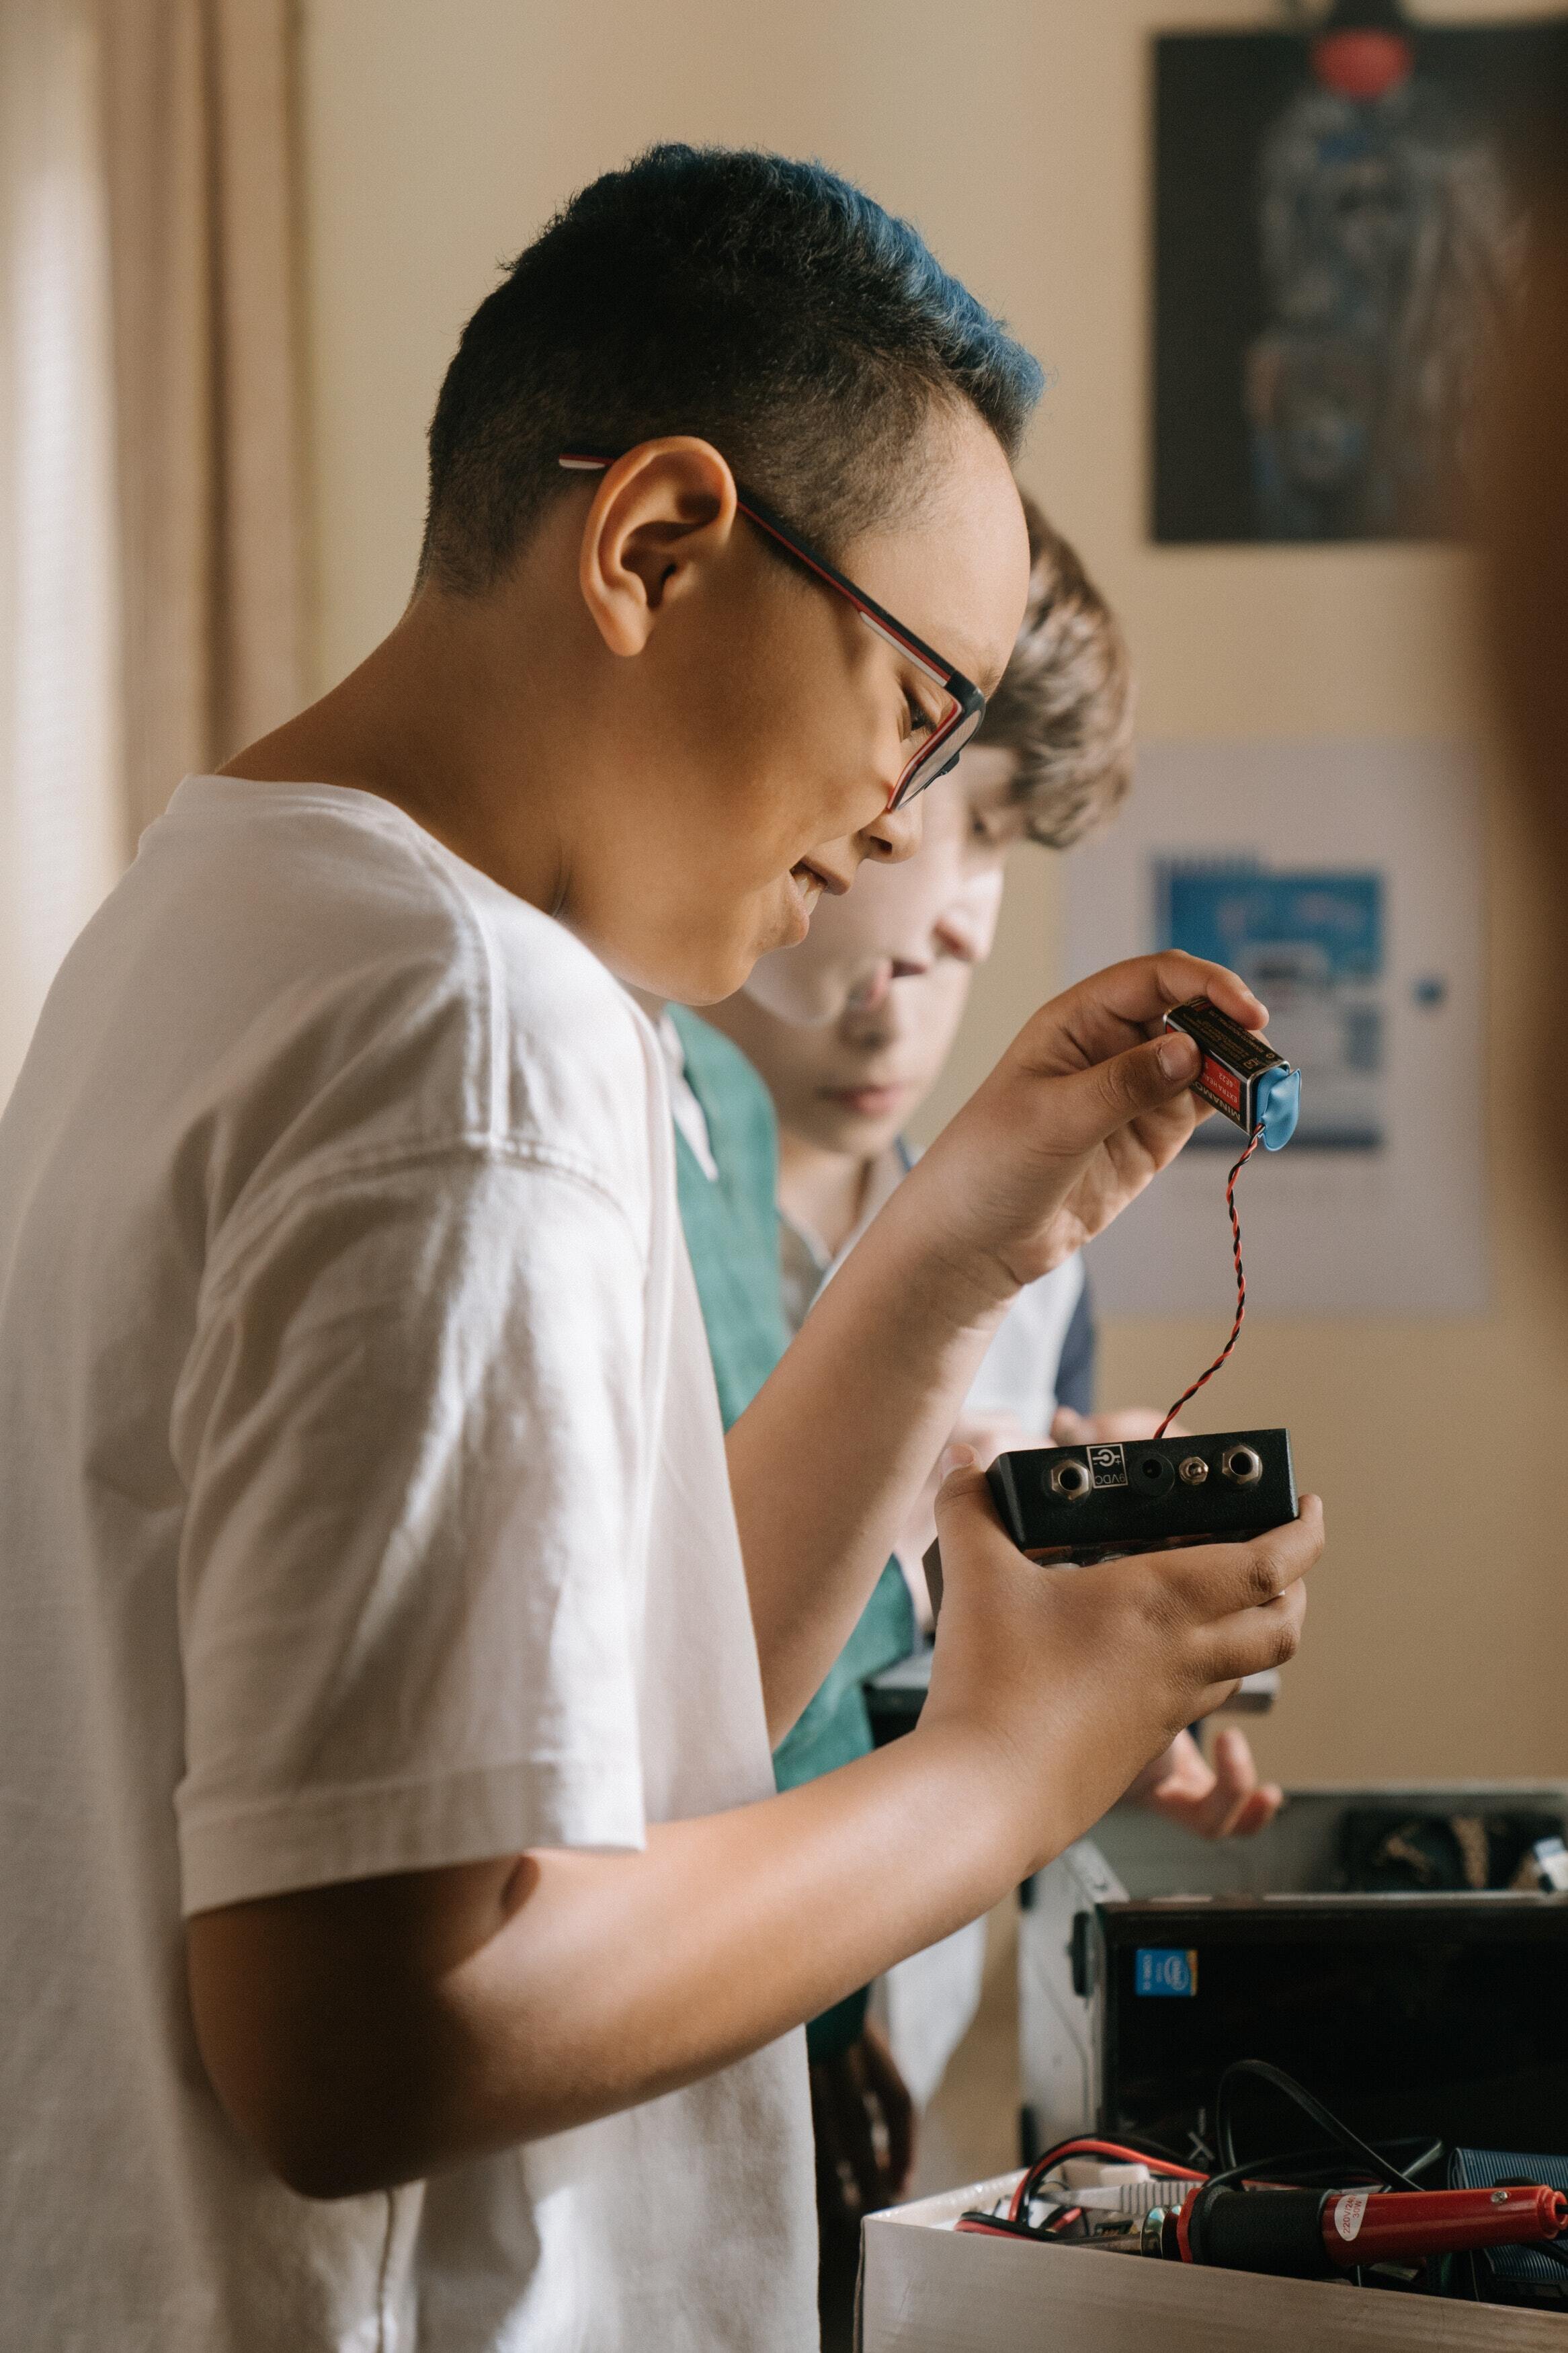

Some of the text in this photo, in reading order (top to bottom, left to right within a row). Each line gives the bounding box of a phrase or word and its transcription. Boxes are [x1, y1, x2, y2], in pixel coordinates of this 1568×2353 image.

[1193, 1081, 1240, 1122] MINAMO
[1219, 1085, 1237, 1103] EXTRA
[1096, 1473, 1125, 1484] 9VDC
[1344, 2194, 1356, 2233] 220V/240
[1353, 2199, 1362, 2219] 30W
